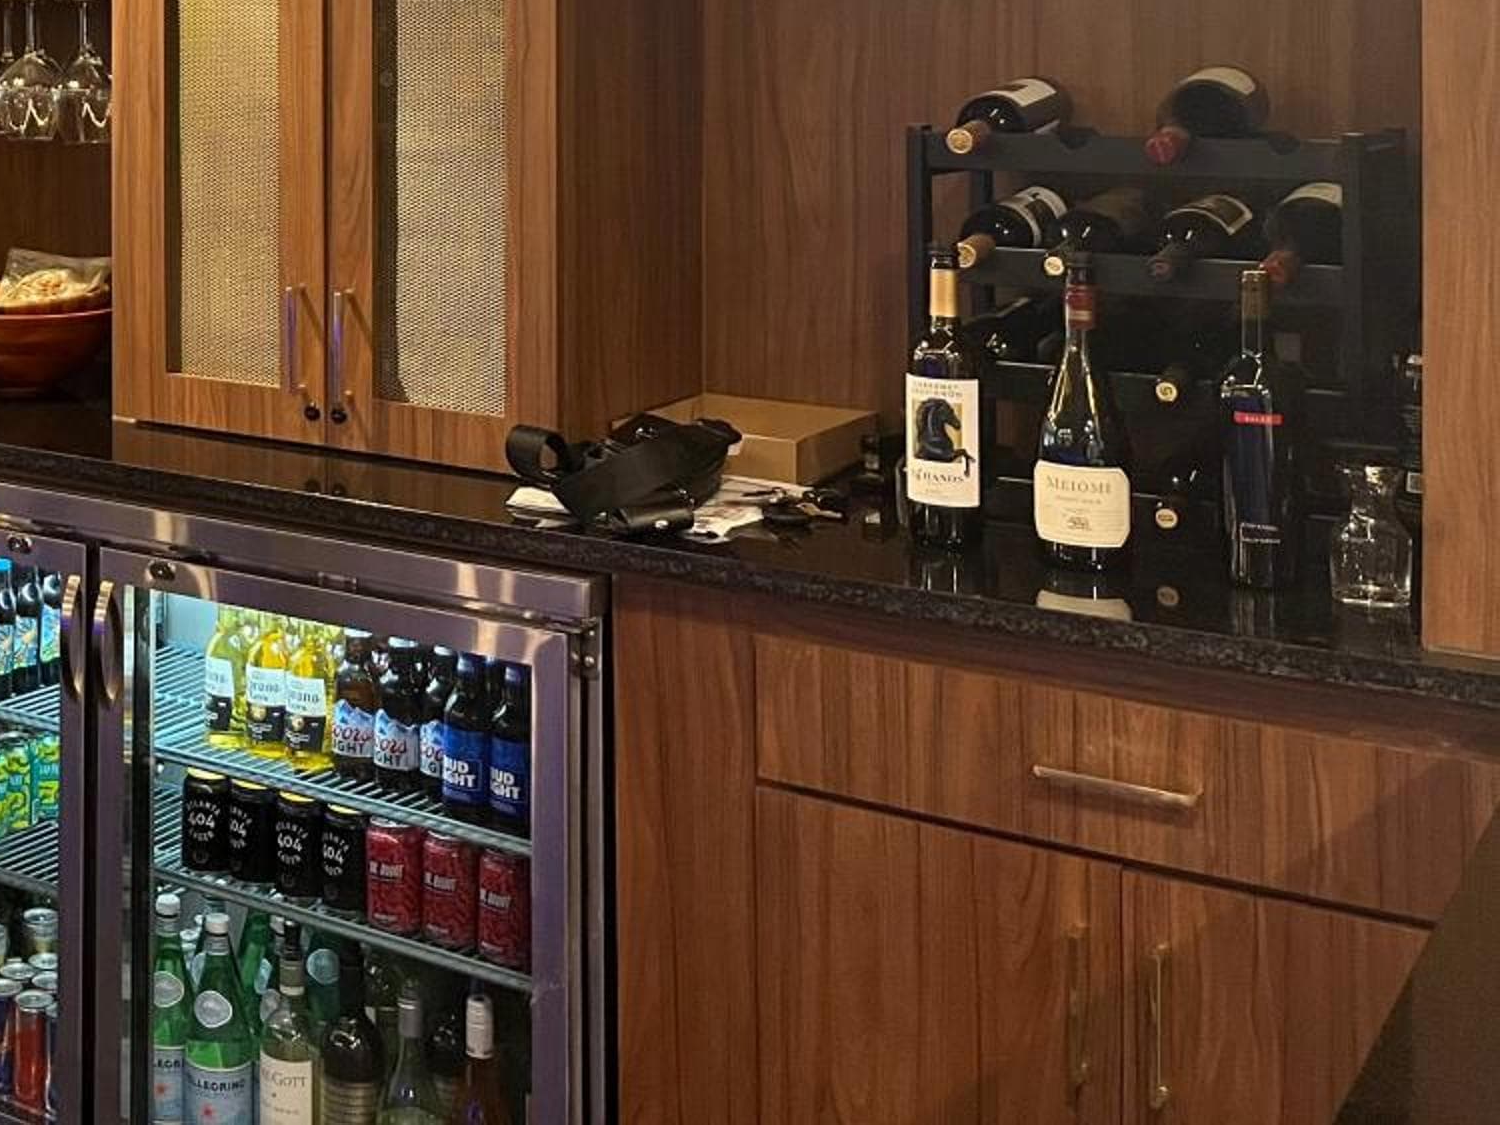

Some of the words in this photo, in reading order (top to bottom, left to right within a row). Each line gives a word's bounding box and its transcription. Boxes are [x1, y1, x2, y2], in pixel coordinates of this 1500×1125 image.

[1045, 475, 1112, 495] MEIOMI
[333, 738, 365, 754] IGHT
[188, 811, 216, 829] 404
[229, 818, 248, 837] 04
[277, 832, 303, 852] 404
